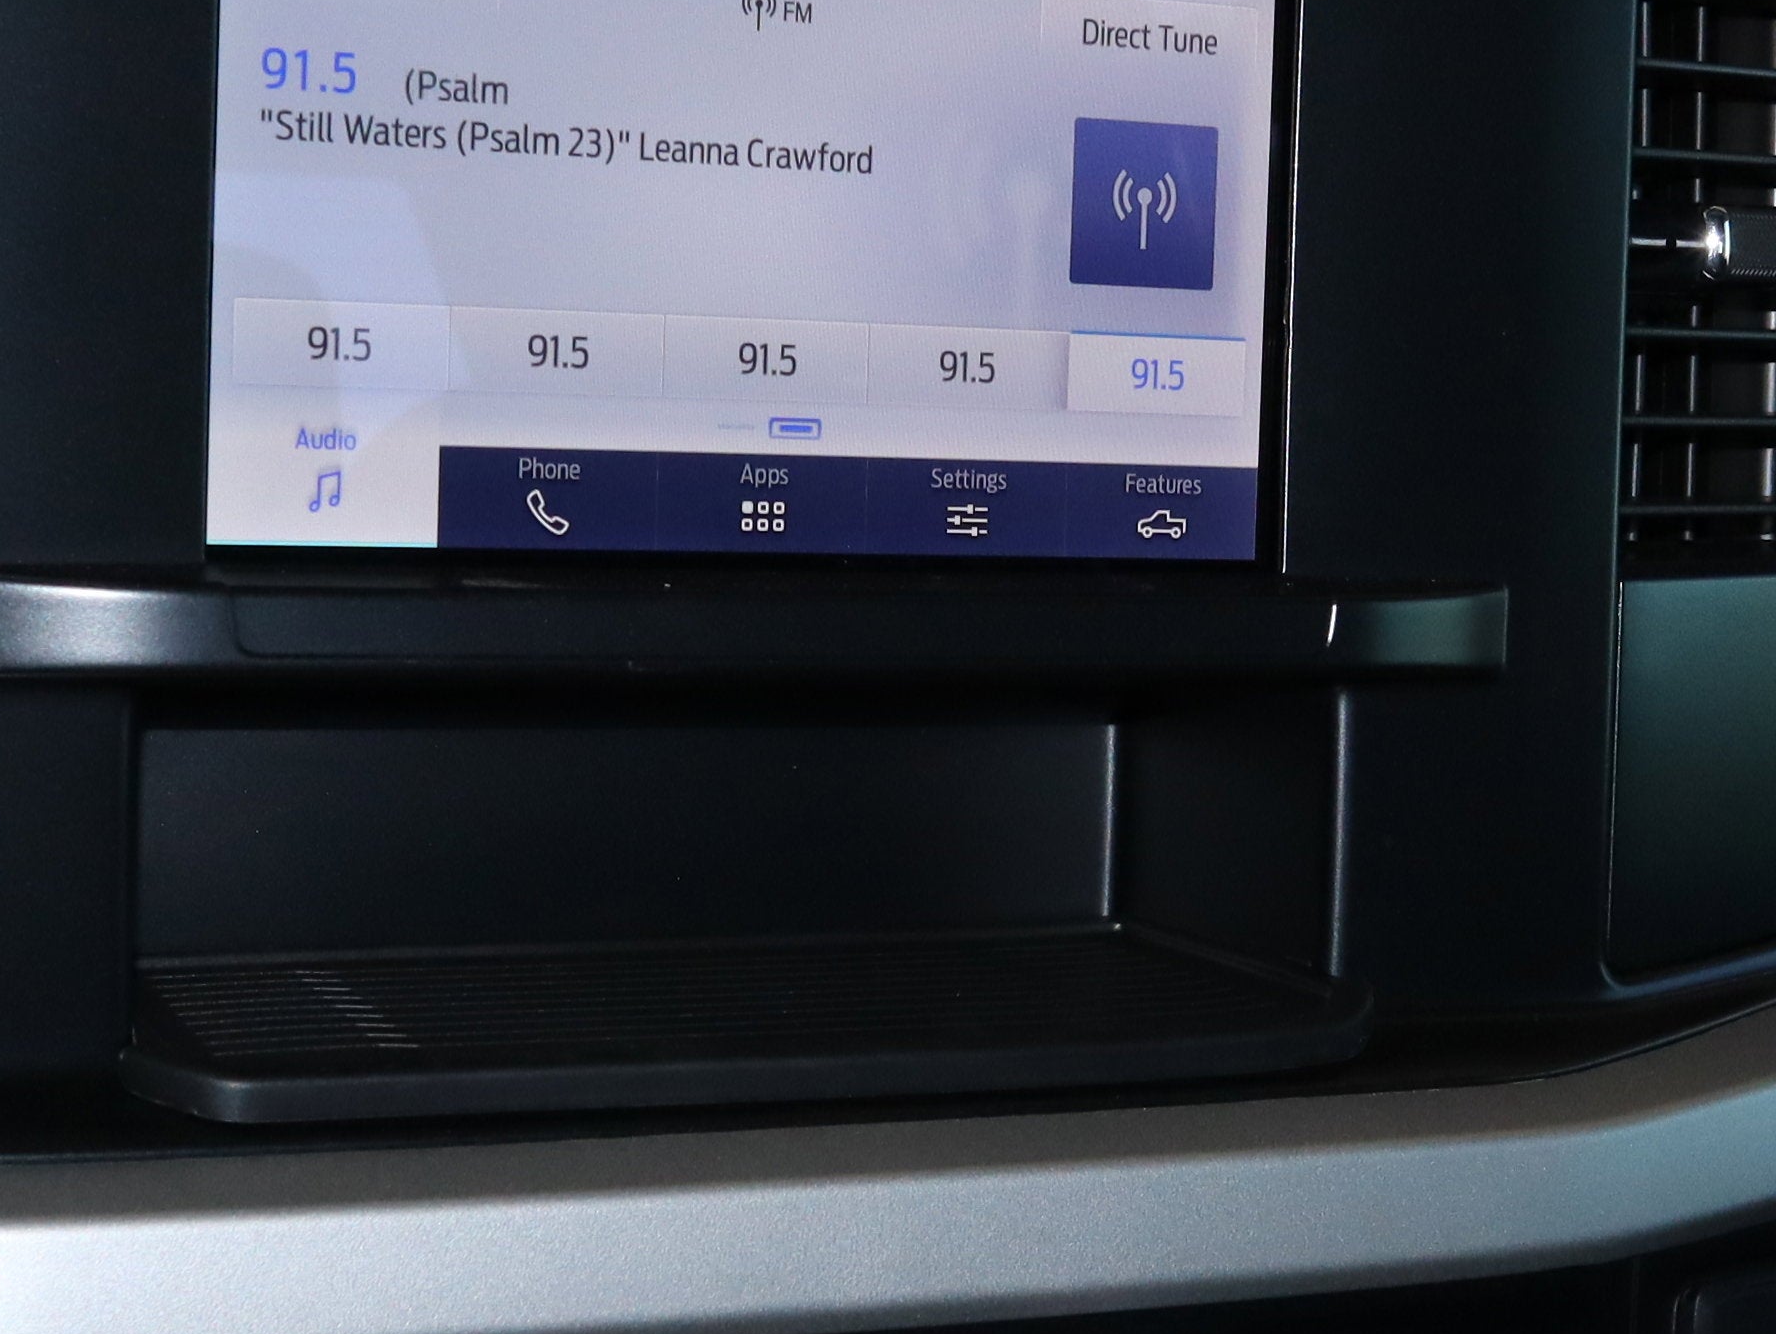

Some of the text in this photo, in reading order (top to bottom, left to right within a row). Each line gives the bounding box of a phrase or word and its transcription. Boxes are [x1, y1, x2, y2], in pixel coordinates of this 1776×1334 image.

[783, 0, 813, 24] FM
[1082, 18, 1218, 56] Direct Tune
[261, 47, 509, 106] 91.5 (Psalm
[261, 109, 873, 175] "Still Waters (Psalm 23)" Leanna Crawford
[307, 326, 371, 362] 91.5
[528, 334, 589, 370] 91.5
[738, 342, 797, 377] 91.5
[939, 350, 995, 384] 91.5
[1131, 358, 1185, 391] 91.5
[295, 426, 357, 450] Audio
[518, 456, 581, 480] Phone
[740, 462, 789, 489] Apps
[931, 468, 1007, 494] Settings
[1125, 472, 1202, 497] Features
